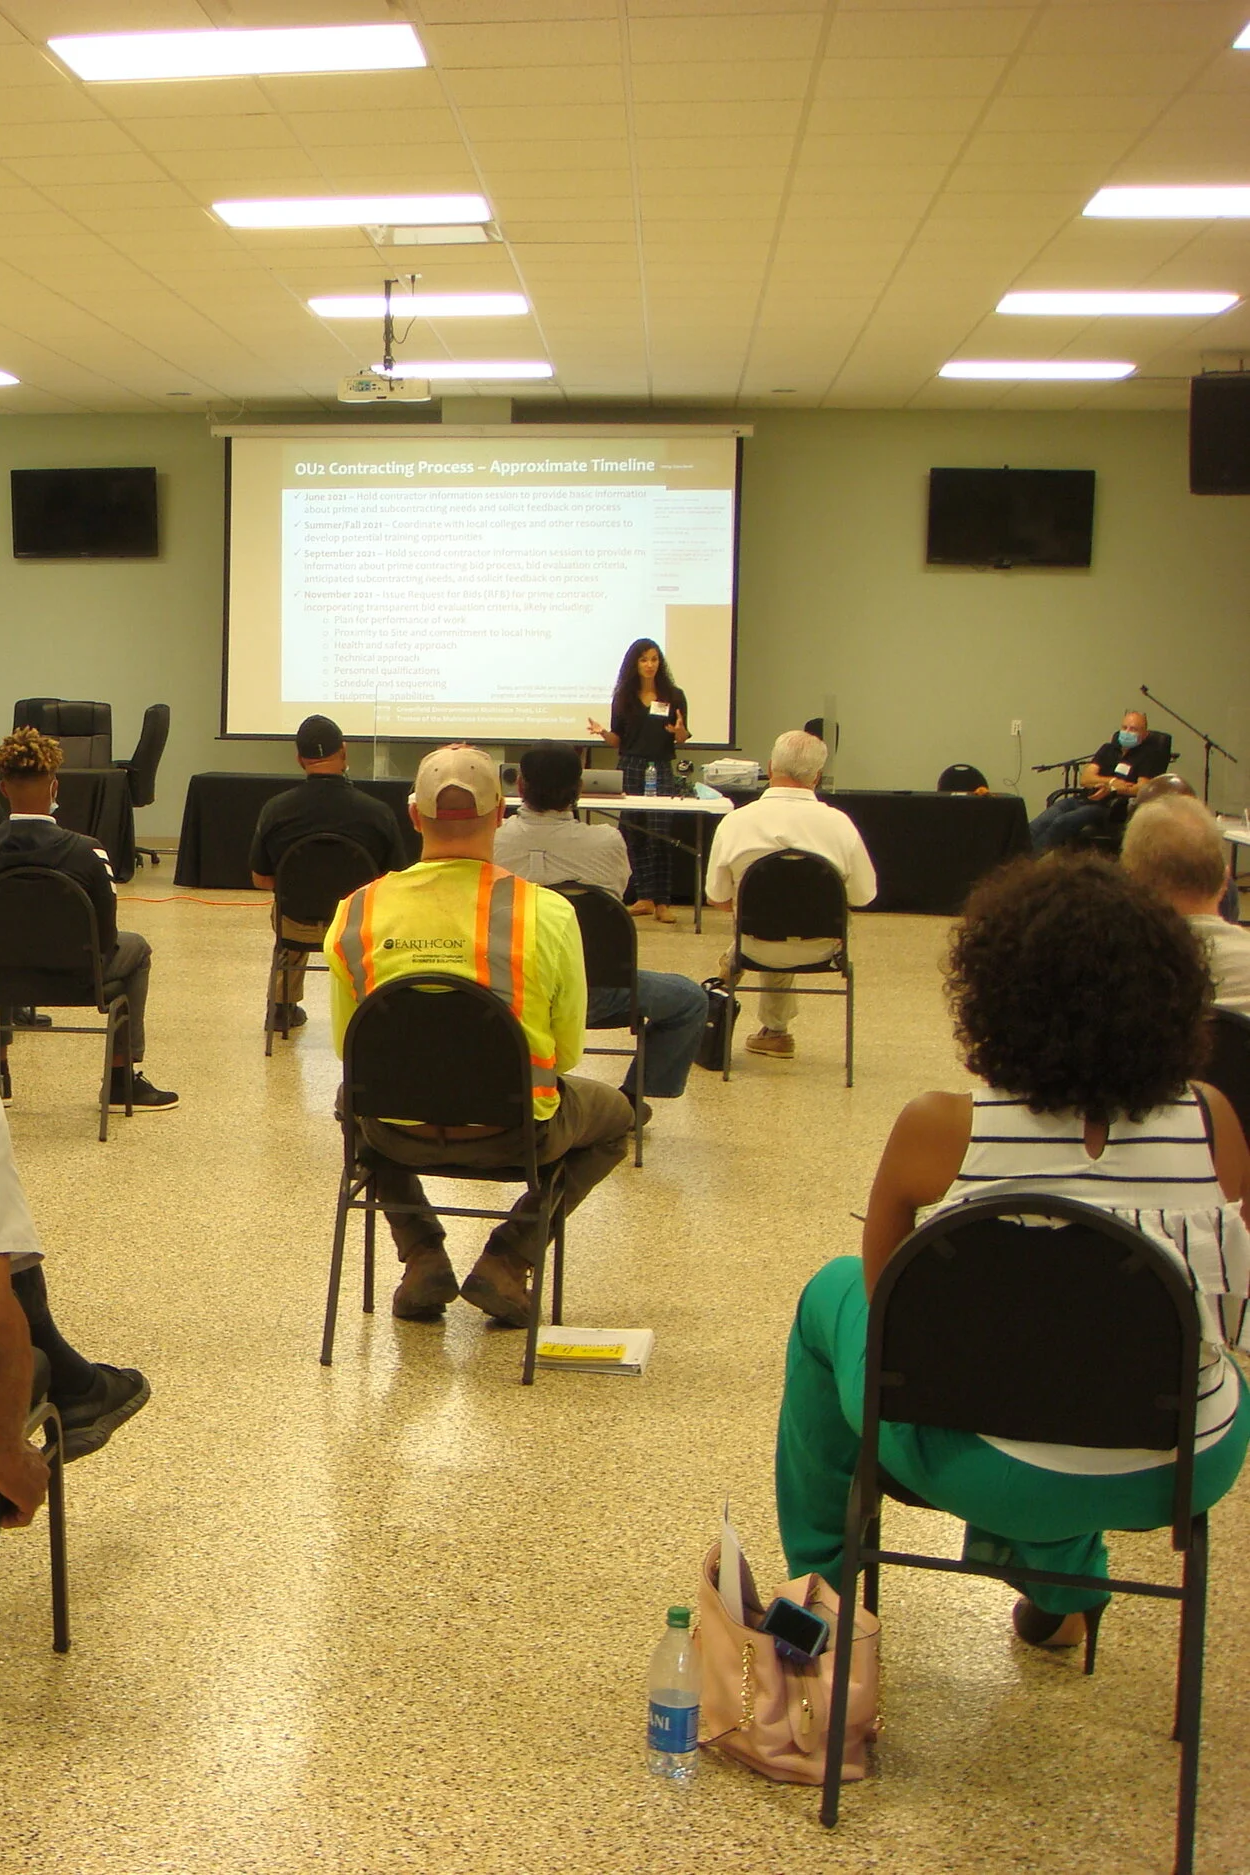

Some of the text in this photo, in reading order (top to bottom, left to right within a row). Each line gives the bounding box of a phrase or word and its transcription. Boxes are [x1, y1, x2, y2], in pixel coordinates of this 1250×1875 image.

[294, 463, 325, 475] OU2
[328, 461, 414, 478] Contracting
[418, 460, 474, 474] Process
[489, 460, 587, 476] Approximate
[590, 459, 654, 472] Timeline
[304, 492, 325, 501] June
[356, 492, 377, 500] Hold
[379, 491, 426, 500] contractor
[429, 491, 482, 499] information
[484, 490, 518, 499] session
[520, 489, 530, 498] to
[532, 489, 567, 500] provide
[569, 489, 592, 497] basic
[304, 505, 330, 514] about
[332, 504, 358, 516] prime
[360, 504, 377, 513] and
[379, 504, 447, 515] subcontracting
[449, 503, 476, 512] needs
[479, 503, 495, 512] and
[498, 502, 524, 511] solicit
[526, 502, 568, 511] feedback
[585, 503, 621, 512] process
[304, 520, 360, 531] Summer/Fall
[391, 520, 442, 528] Coordinate
[444, 519, 464, 528] with
[466, 519, 487, 528] local
[489, 519, 526, 530] colleges
[528, 518, 546, 527] and
[548, 518, 573, 527] other
[622, 518, 633, 526] to
[304, 532, 483, 543] develop potential training opportunities
[304, 548, 354, 559] September
[385, 548, 406, 557] Hold
[408, 548, 440, 557] second
[443, 548, 490, 557] contractor
[493, 547, 546, 556] information
[549, 547, 582, 556] session
[584, 547, 595, 556] to
[596, 547, 631, 558] provide
[304, 559, 627, 572] information about prime contracting bid process, bid evaluation criteria,
[304, 574, 354, 585] anticipated
[356, 573, 423, 584] subcontracting
[425, 573, 455, 583] needs,
[457, 573, 474, 582] and
[476, 573, 502, 582] solicit
[505, 572, 545, 581] feedback
[563, 574, 598, 583] process
[304, 590, 351, 598] November
[382, 590, 405, 598] Issue
[407, 589, 444, 601] Request
[447, 589, 460, 598] for
[462, 589, 482, 598] Bids
[511, 589, 525, 598] for
[527, 589, 553, 600] prime
[556, 588, 607, 598] contractor,
[304, 602, 364, 613] incorporating
[366, 602, 418, 613] transparent
[421, 602, 435, 611] bid
[437, 602, 485, 611] evaluation
[486, 601, 521, 611] criteria,
[524, 601, 546, 612] likely
[334, 614, 466, 625] Plan for performance of work
[335, 627, 552, 638] Proximity to Site and commitment to local hiring
[335, 640, 457, 651] Health and safety approach
[334, 653, 419, 664] Technical approach
[334, 666, 440, 677] Personnel qualifications
[334, 678, 446, 690] Schedule and sequencing
[334, 692, 435, 703] Equipme apabilities
